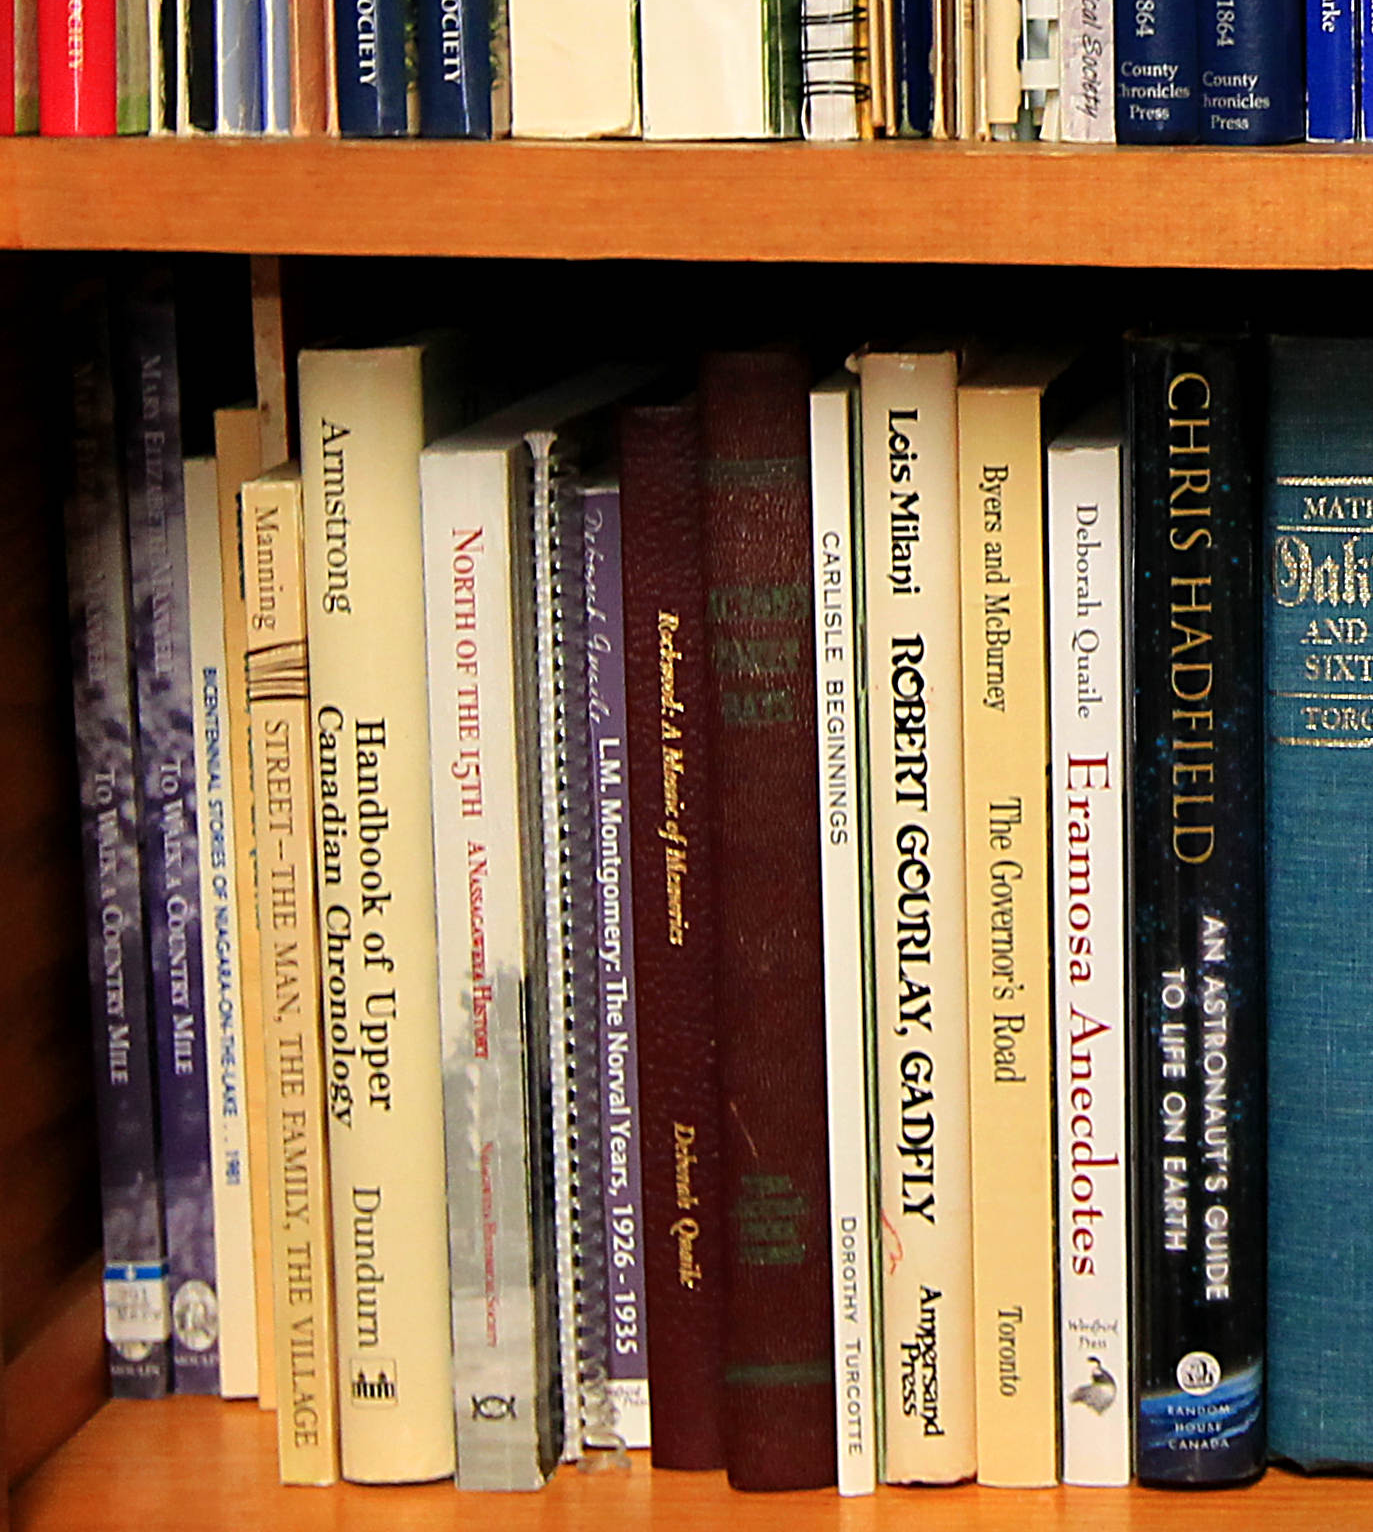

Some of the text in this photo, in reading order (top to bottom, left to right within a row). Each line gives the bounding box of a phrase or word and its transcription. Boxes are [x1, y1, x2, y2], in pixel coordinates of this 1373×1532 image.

[1121, 61, 1178, 79] County
[1129, 104, 1170, 120] Press
[252, 506, 284, 630] Manning
[320, 419, 352, 614] Armstrong
[1168, 372, 1215, 864] CHRIS HADFIELD
[1300, 618, 1367, 644] AND
[822, 532, 848, 845] CARLISLE BEGINNINGS
[317, 707, 354, 1129] Canadian Chronology
[891, 634, 936, 1225] ROBERT GOURLAY, GADFLY
[989, 797, 1026, 1083] The Governor's Road
[1066, 752, 1111, 986] Eramosa
[352, 718, 396, 1347] Handbook of Upper Dundurn
[1070, 1005, 1118, 1276] Anecdotes
[1162, 970, 1187, 1251] TO LIFE ON EARTH
[1203, 915, 1229, 1300] AN ASTRONAUT'S GUIDE
